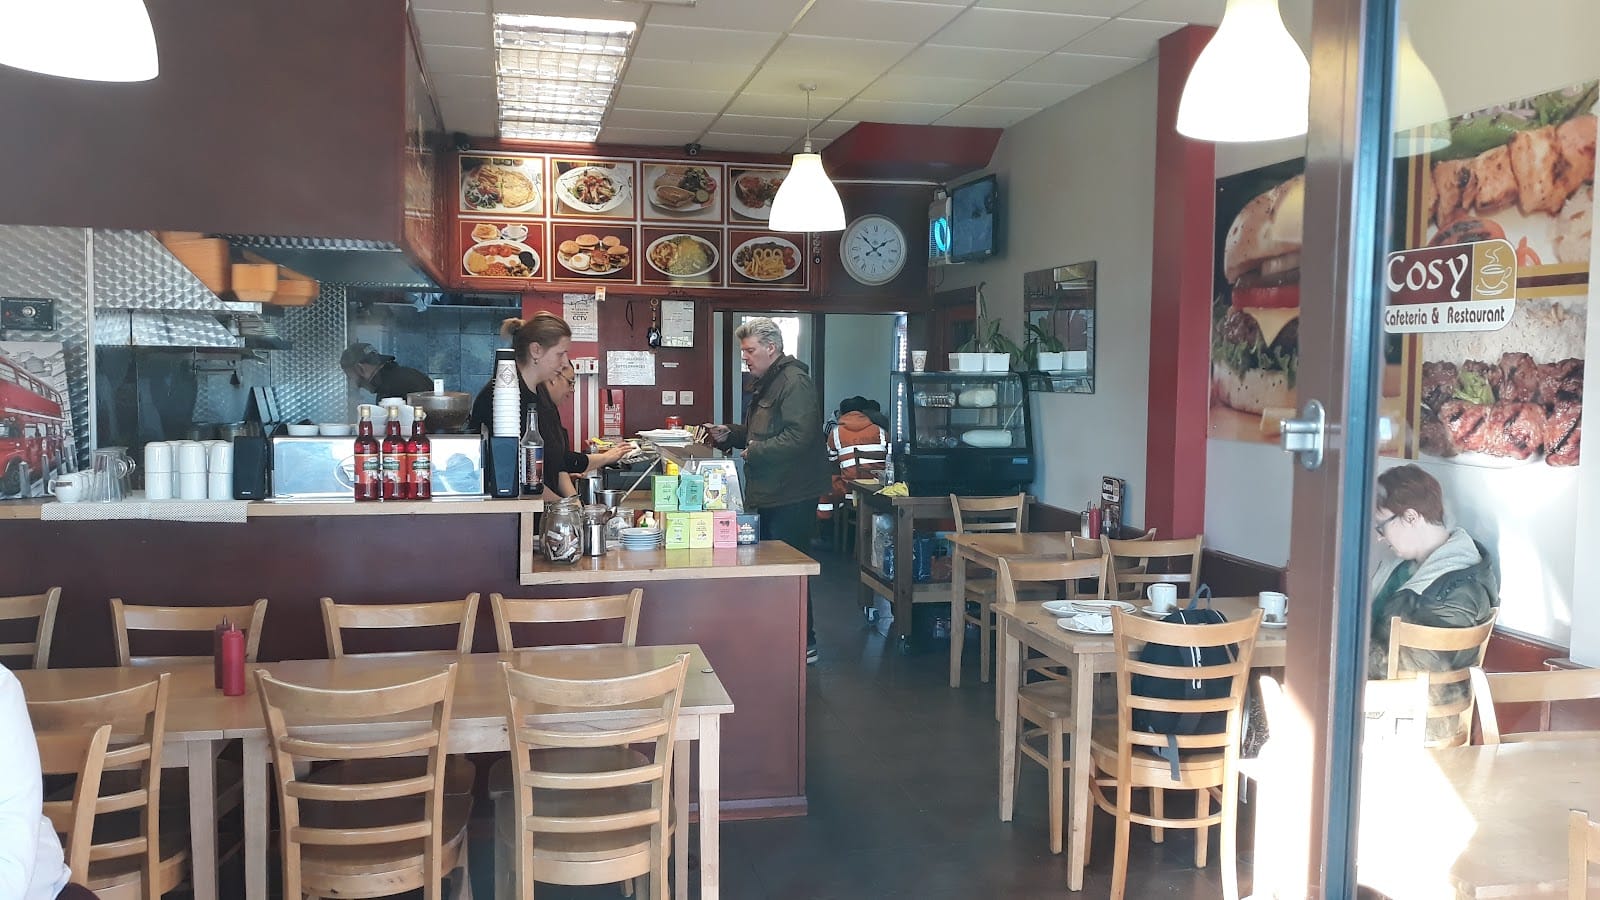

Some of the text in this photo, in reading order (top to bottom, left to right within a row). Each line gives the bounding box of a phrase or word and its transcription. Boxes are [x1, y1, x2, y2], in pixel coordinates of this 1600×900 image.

[1387, 253, 1469, 299] Cosy
[1385, 305, 1505, 326] Cafeteria & Restaurant
